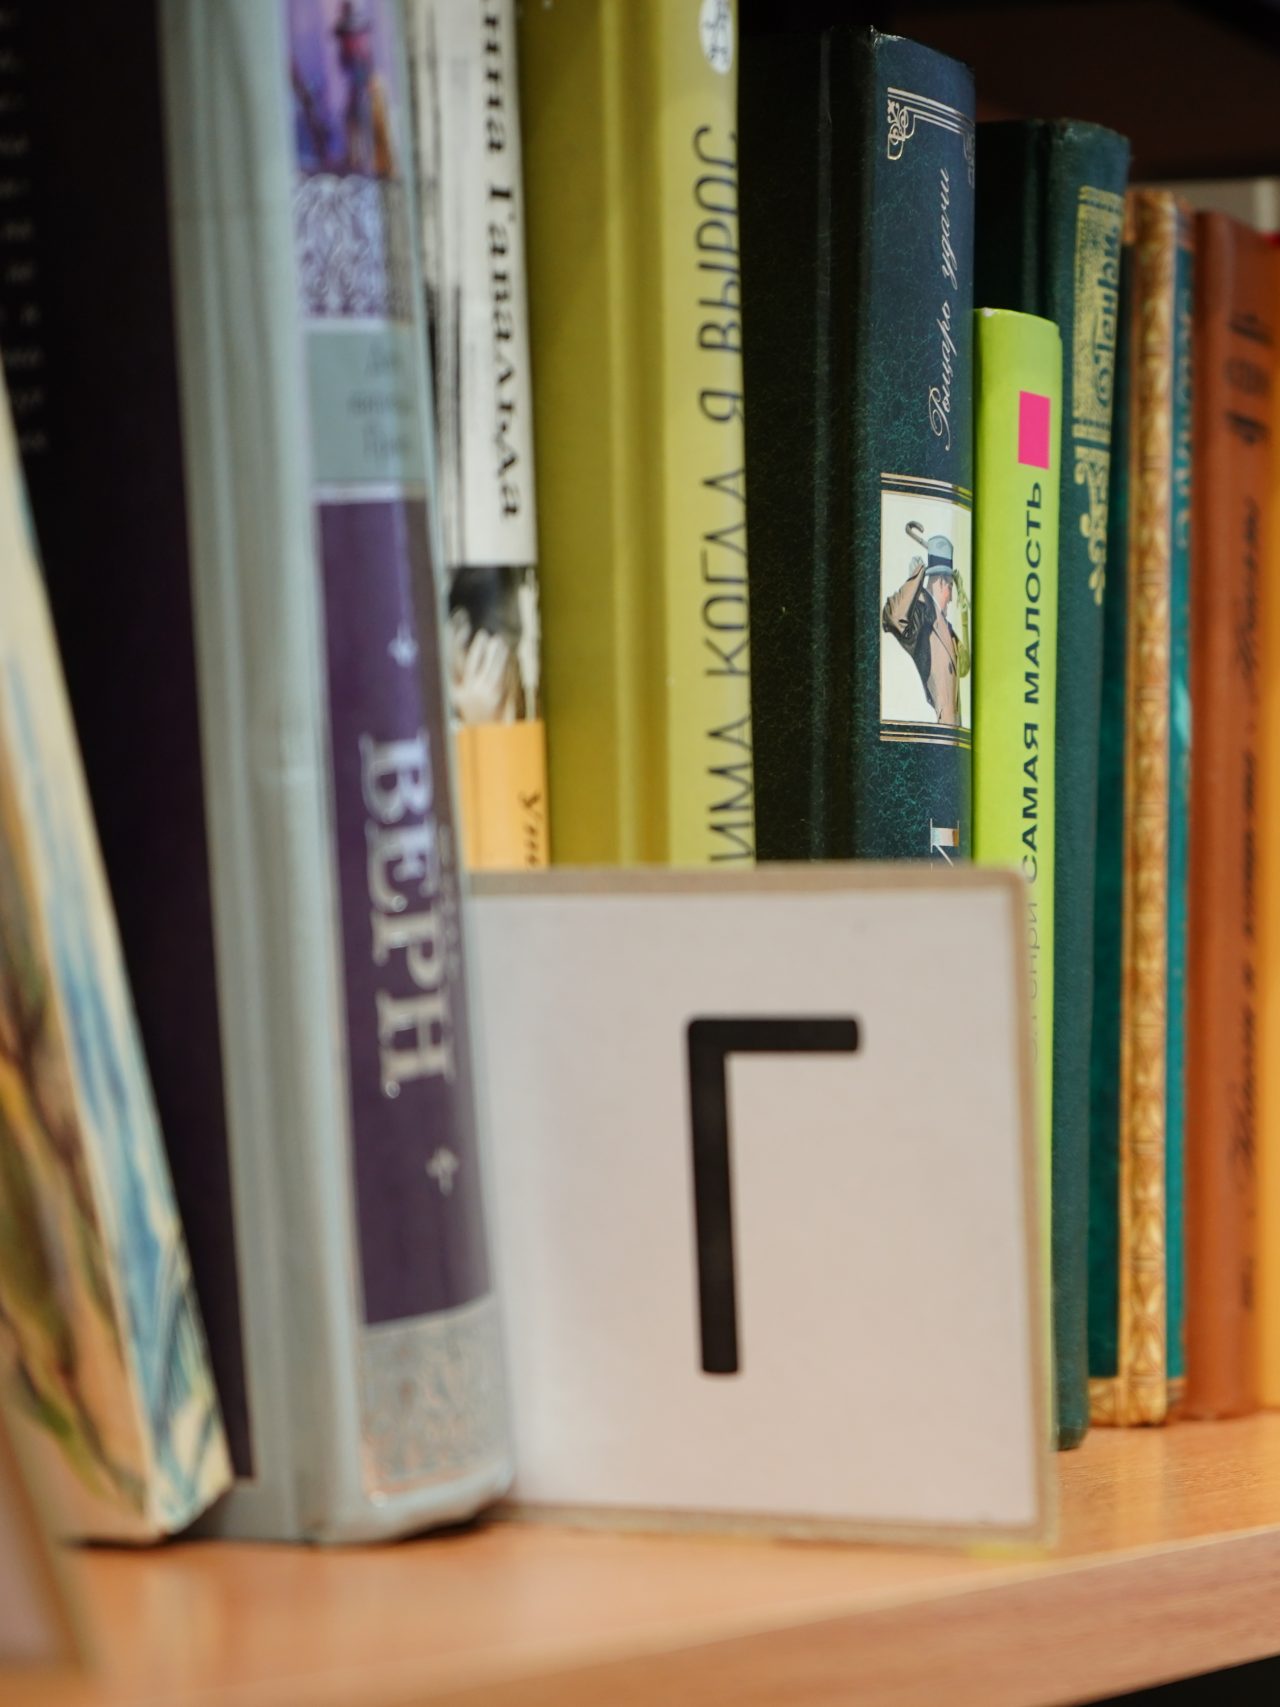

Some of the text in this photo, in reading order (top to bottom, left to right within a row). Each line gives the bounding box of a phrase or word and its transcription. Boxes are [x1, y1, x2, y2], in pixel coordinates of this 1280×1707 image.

[482, 0, 521, 520] нна Гавальда
[692, 124, 742, 354] ВЫРОС
[927, 166, 958, 452] Рыцарь удачи
[697, 388, 745, 424] Я
[700, 465, 750, 680] КОГДА
[1023, 482, 1043, 705] МАЛОСТЬ
[708, 717, 754, 864] ИМА
[1020, 721, 1040, 884] САМАЯ
[360, 730, 455, 1099] ВЕРН
[686, 1017, 860, 1376] Г
